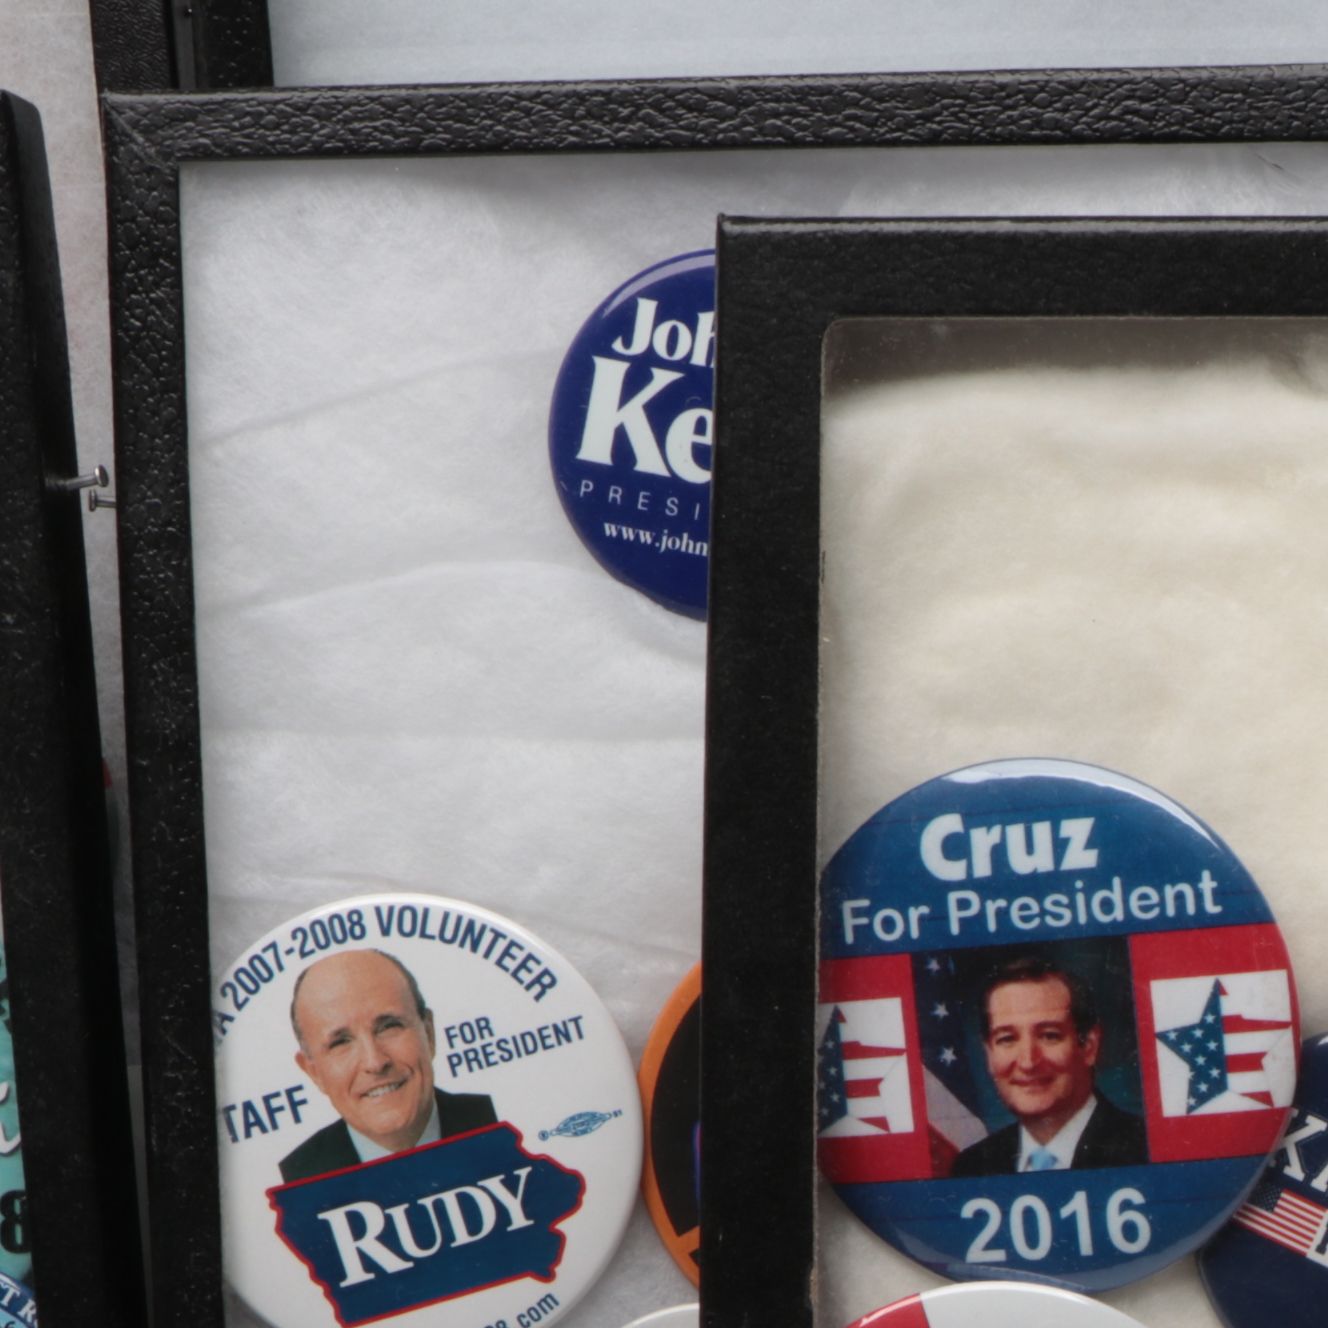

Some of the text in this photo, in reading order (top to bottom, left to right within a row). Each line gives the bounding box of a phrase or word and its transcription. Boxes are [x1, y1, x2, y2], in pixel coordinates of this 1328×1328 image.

[920, 813, 1099, 882] Cruz
[842, 869, 1222, 945] For President
[220, 908, 367, 1011] 2007-2008
[374, 904, 559, 1003] VOLUNTEER
[444, 1016, 495, 1049] FOR
[447, 1015, 585, 1078] PRESIDENT
[960, 1188, 1151, 1264] 2016
